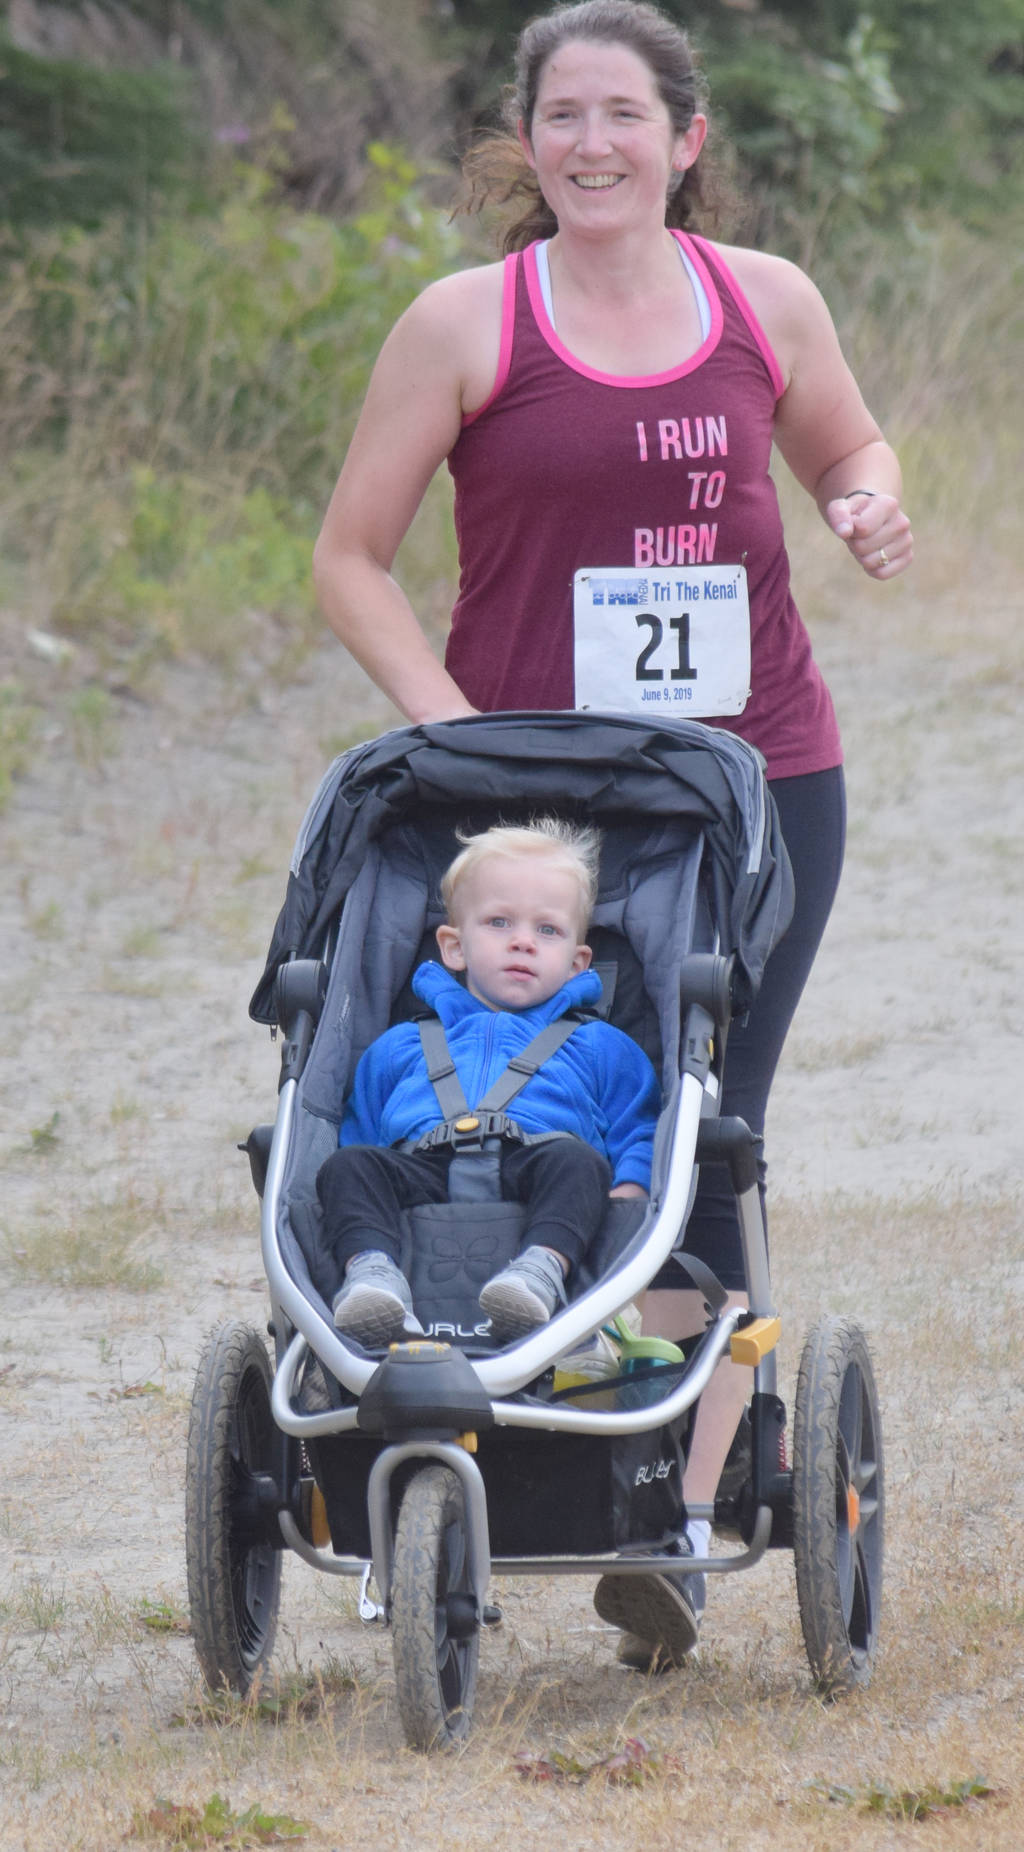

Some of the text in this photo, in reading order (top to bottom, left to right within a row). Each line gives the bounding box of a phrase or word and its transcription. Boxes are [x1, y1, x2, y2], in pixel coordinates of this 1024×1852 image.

[636, 415, 729, 462] I RUN
[687, 470, 726, 510] TO
[634, 523, 718, 567] BURN
[652, 581, 671, 602] Tri
[676, 581, 700, 602] The
[703, 579, 738, 601] Kenai
[634, 612, 698, 681] 21
[641, 687, 693, 703] June 9, 2019
